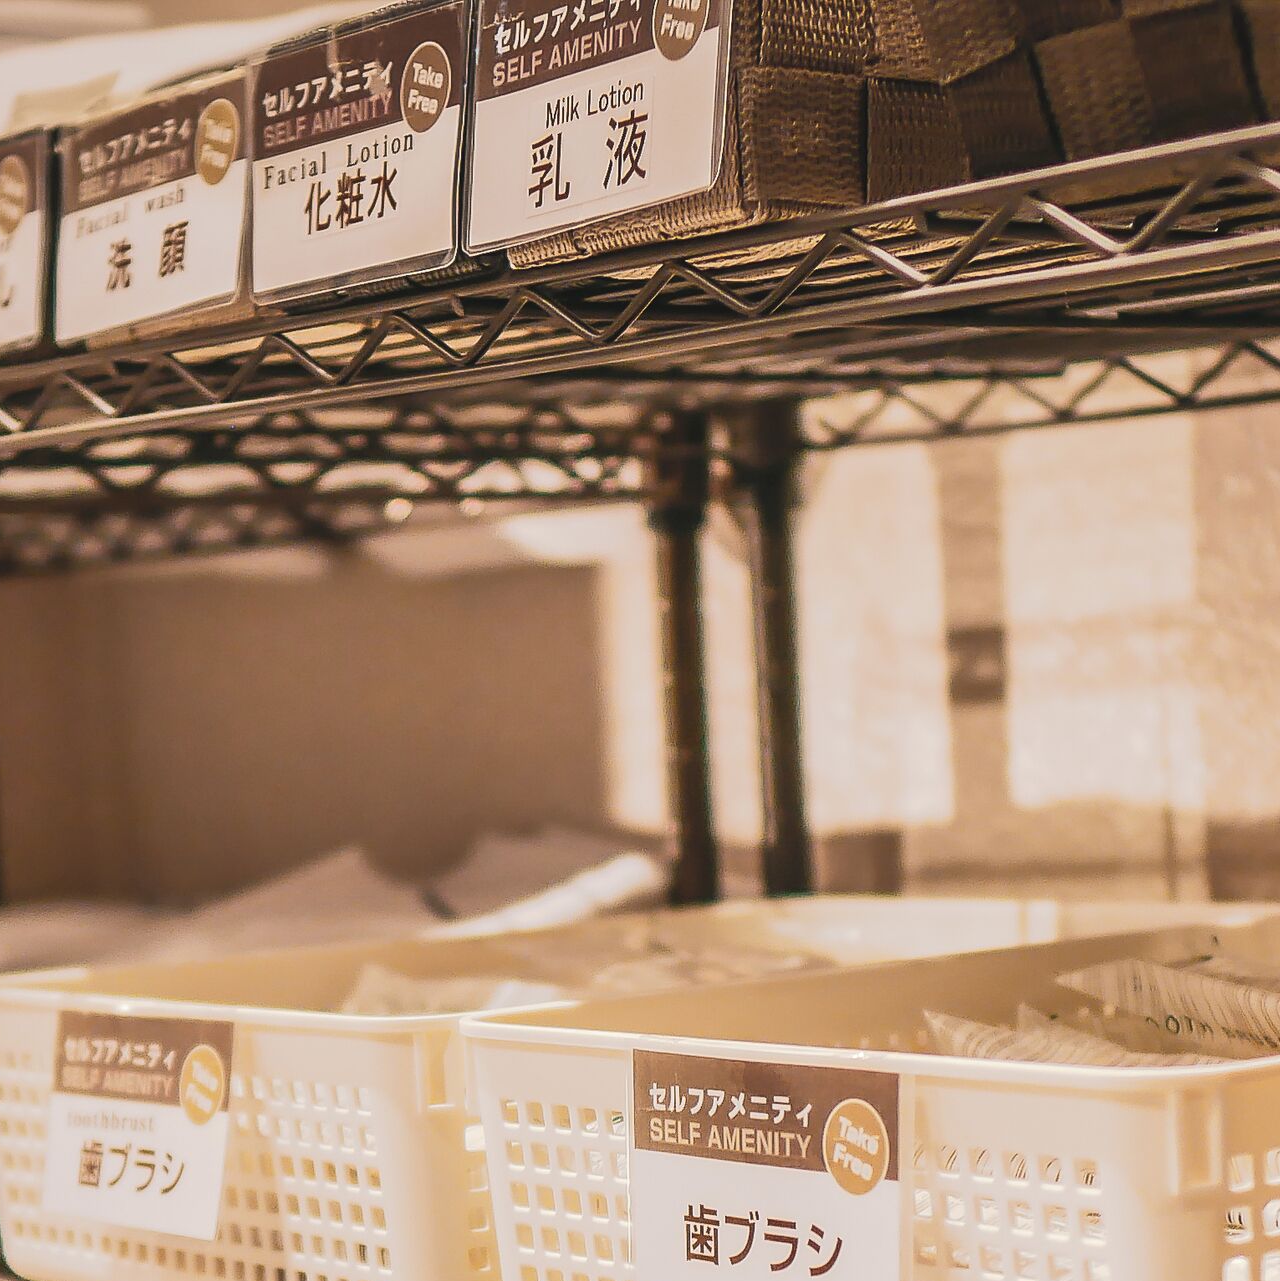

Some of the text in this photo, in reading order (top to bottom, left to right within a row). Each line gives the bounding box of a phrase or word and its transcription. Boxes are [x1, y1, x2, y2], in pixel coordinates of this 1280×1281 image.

[660, 12, 695, 41] Free
[412, 62, 444, 89] Take
[493, 17, 642, 87] SELF AMENITY
[263, 60, 393, 118] セルフアメニティ
[408, 89, 439, 115] Free
[545, 80, 644, 129] Milk Lotion
[263, 90, 393, 148] SELF AMENITY
[264, 133, 414, 190] Facial Lotion
[304, 161, 398, 236] 化粧水
[649, 1082, 814, 1129] セルフアメニティ
[649, 1117, 812, 1159] SELF AMENITY
[837, 1115, 880, 1156] Take
[79, 1140, 185, 1195] 歯ブラシ
[832, 1143, 875, 1182] Free
[683, 1204, 843, 1278] 歯ブラシ
